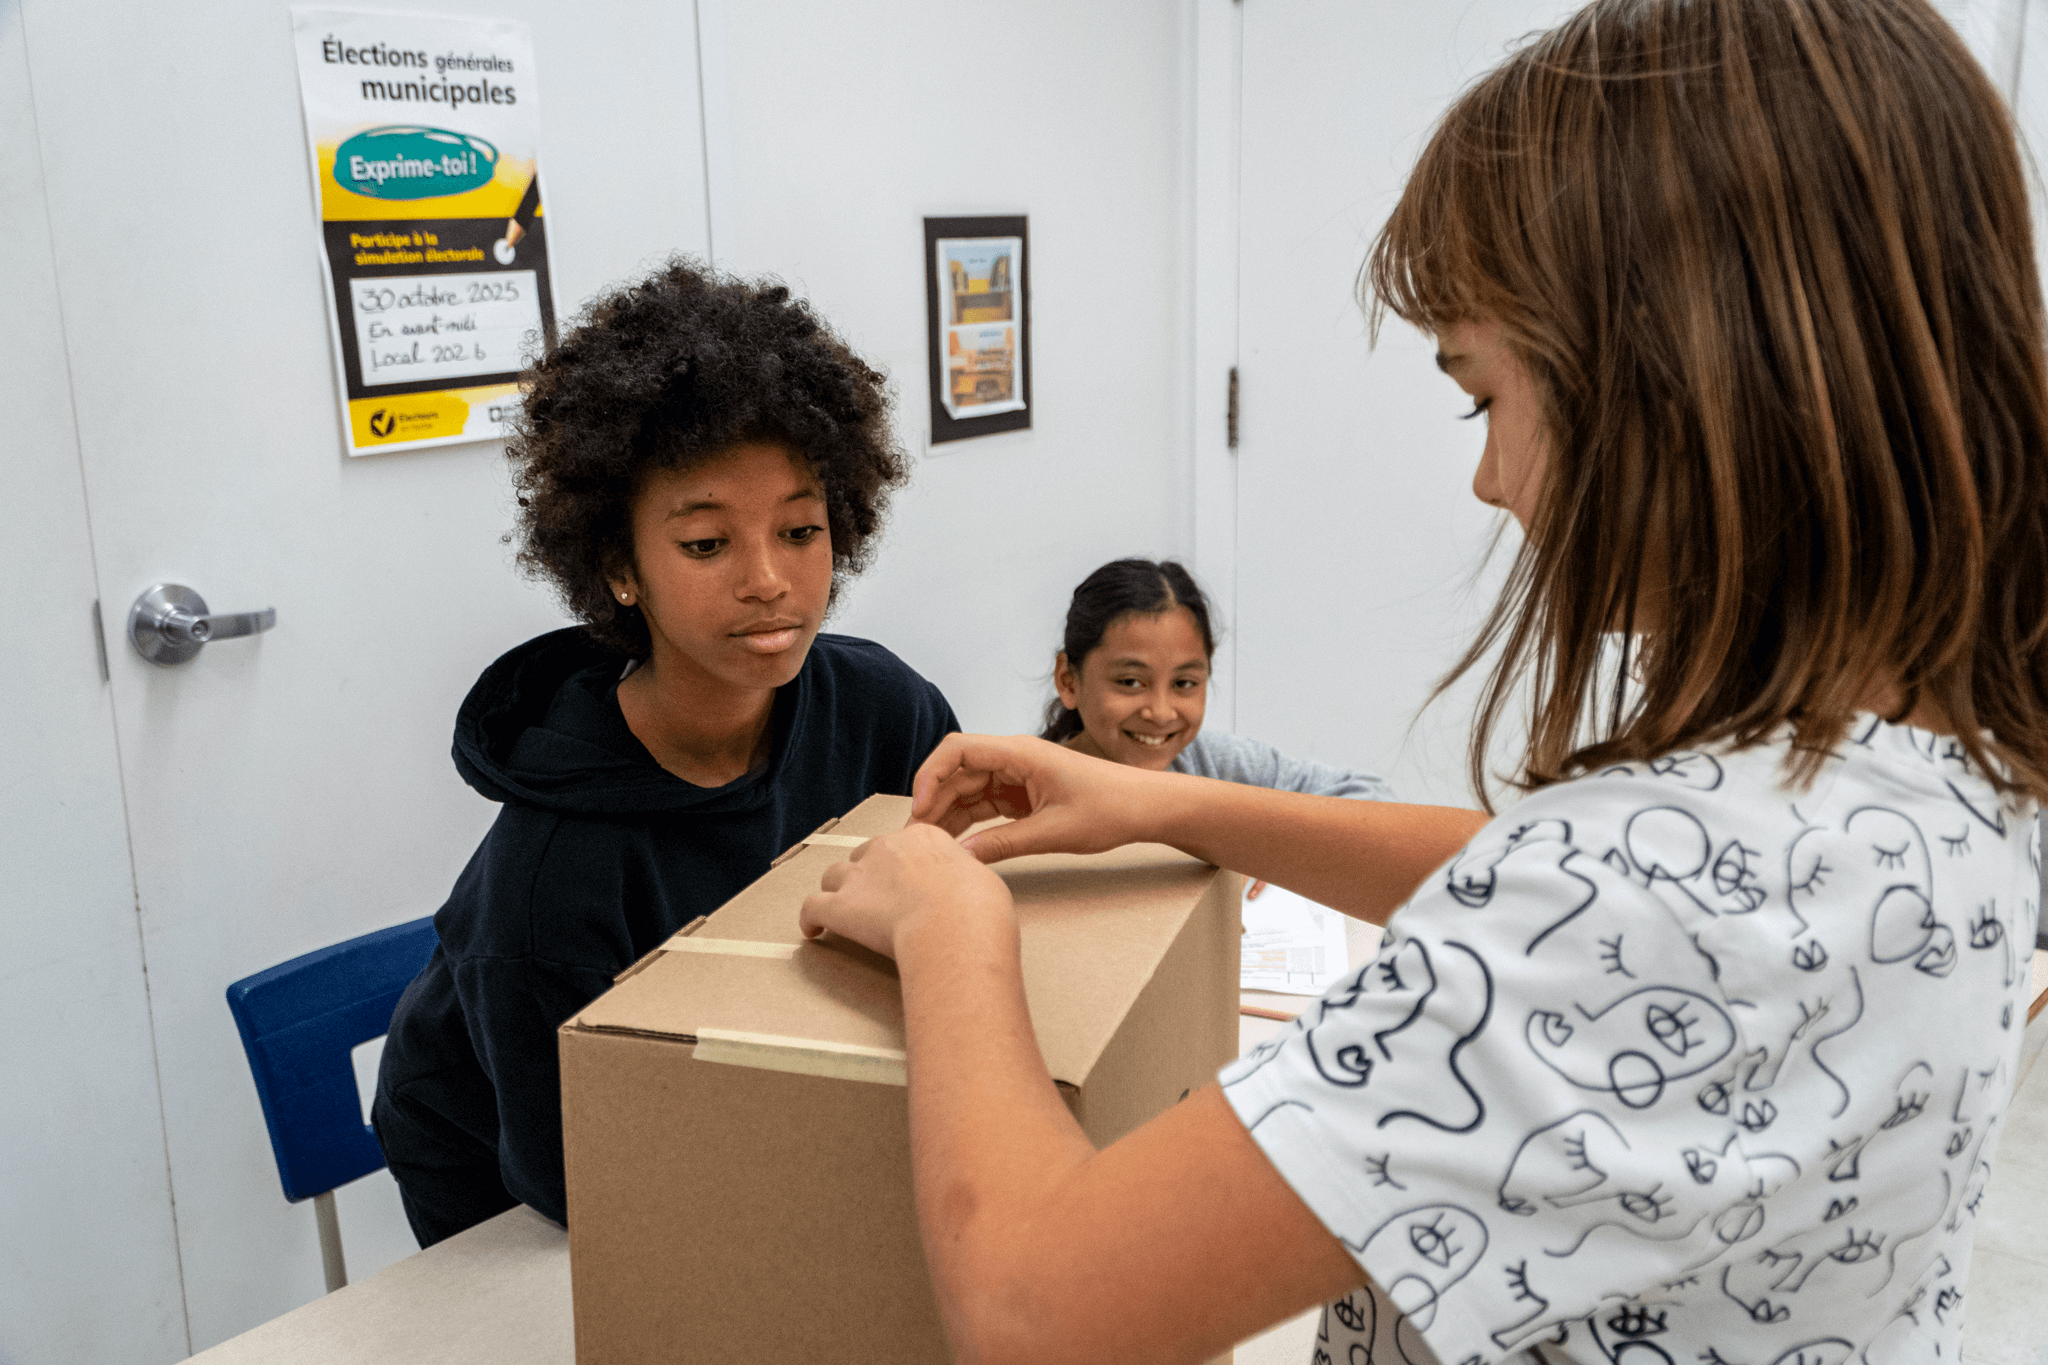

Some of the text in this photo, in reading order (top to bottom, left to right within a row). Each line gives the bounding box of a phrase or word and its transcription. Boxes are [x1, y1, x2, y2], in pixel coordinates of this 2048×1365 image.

[322, 33, 514, 74] Élections générales
[361, 75, 517, 109] municipales
[350, 232, 411, 249] Participe
[354, 246, 485, 266] simulation électorale
[358, 281, 519, 311] 30 octobre 2025
[369, 321, 394, 338] En
[372, 341, 425, 371] Local
